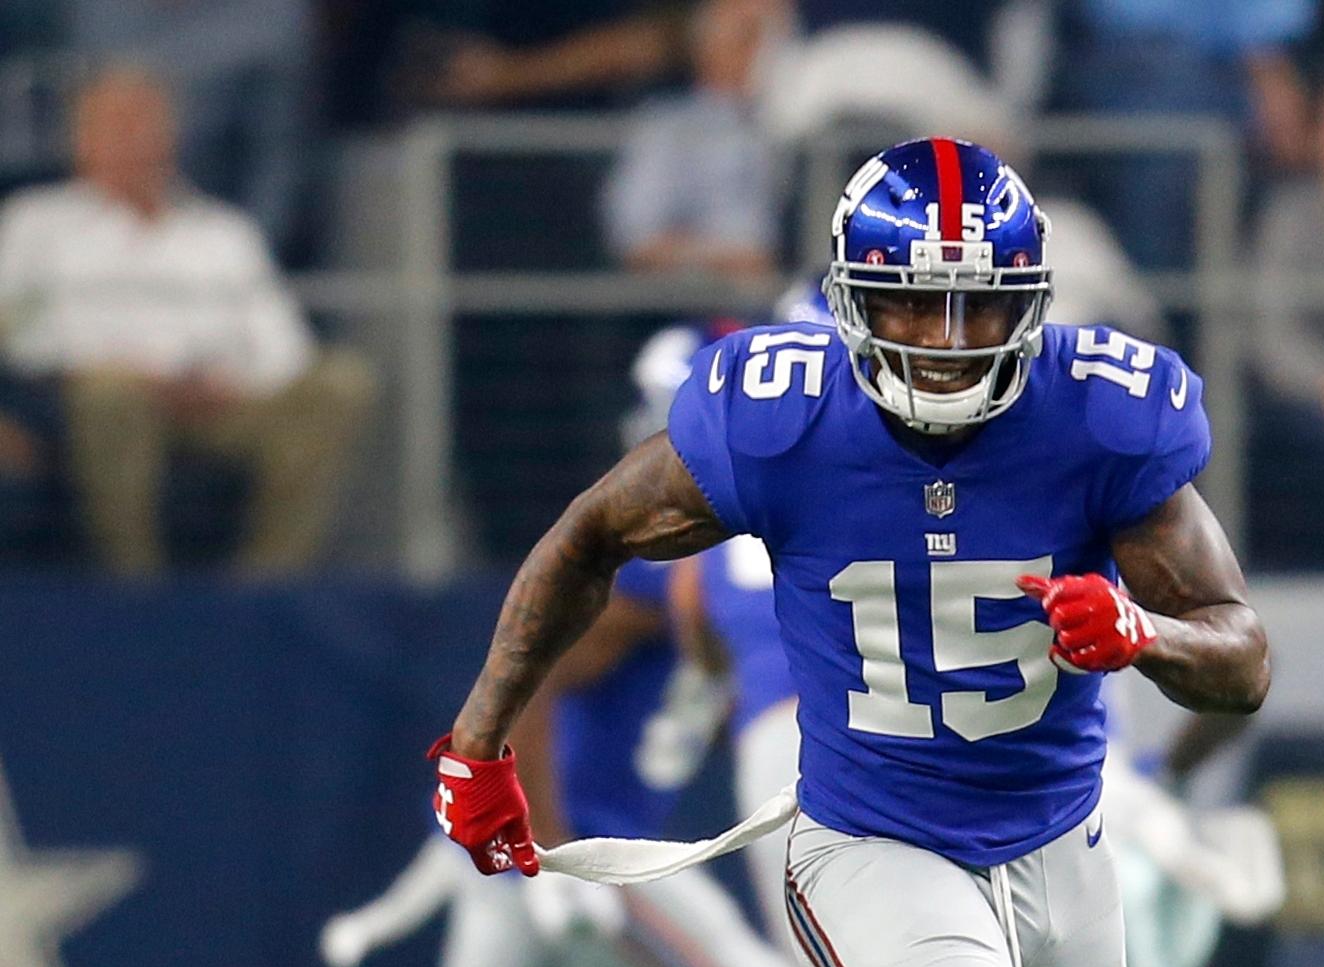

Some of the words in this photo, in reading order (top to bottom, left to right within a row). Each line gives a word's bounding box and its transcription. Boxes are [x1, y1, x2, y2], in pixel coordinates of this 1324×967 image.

[925, 202, 985, 240] 15
[742, 331, 830, 400] 15
[1070, 327, 1156, 398] 15
[828, 555, 1059, 742] 15
